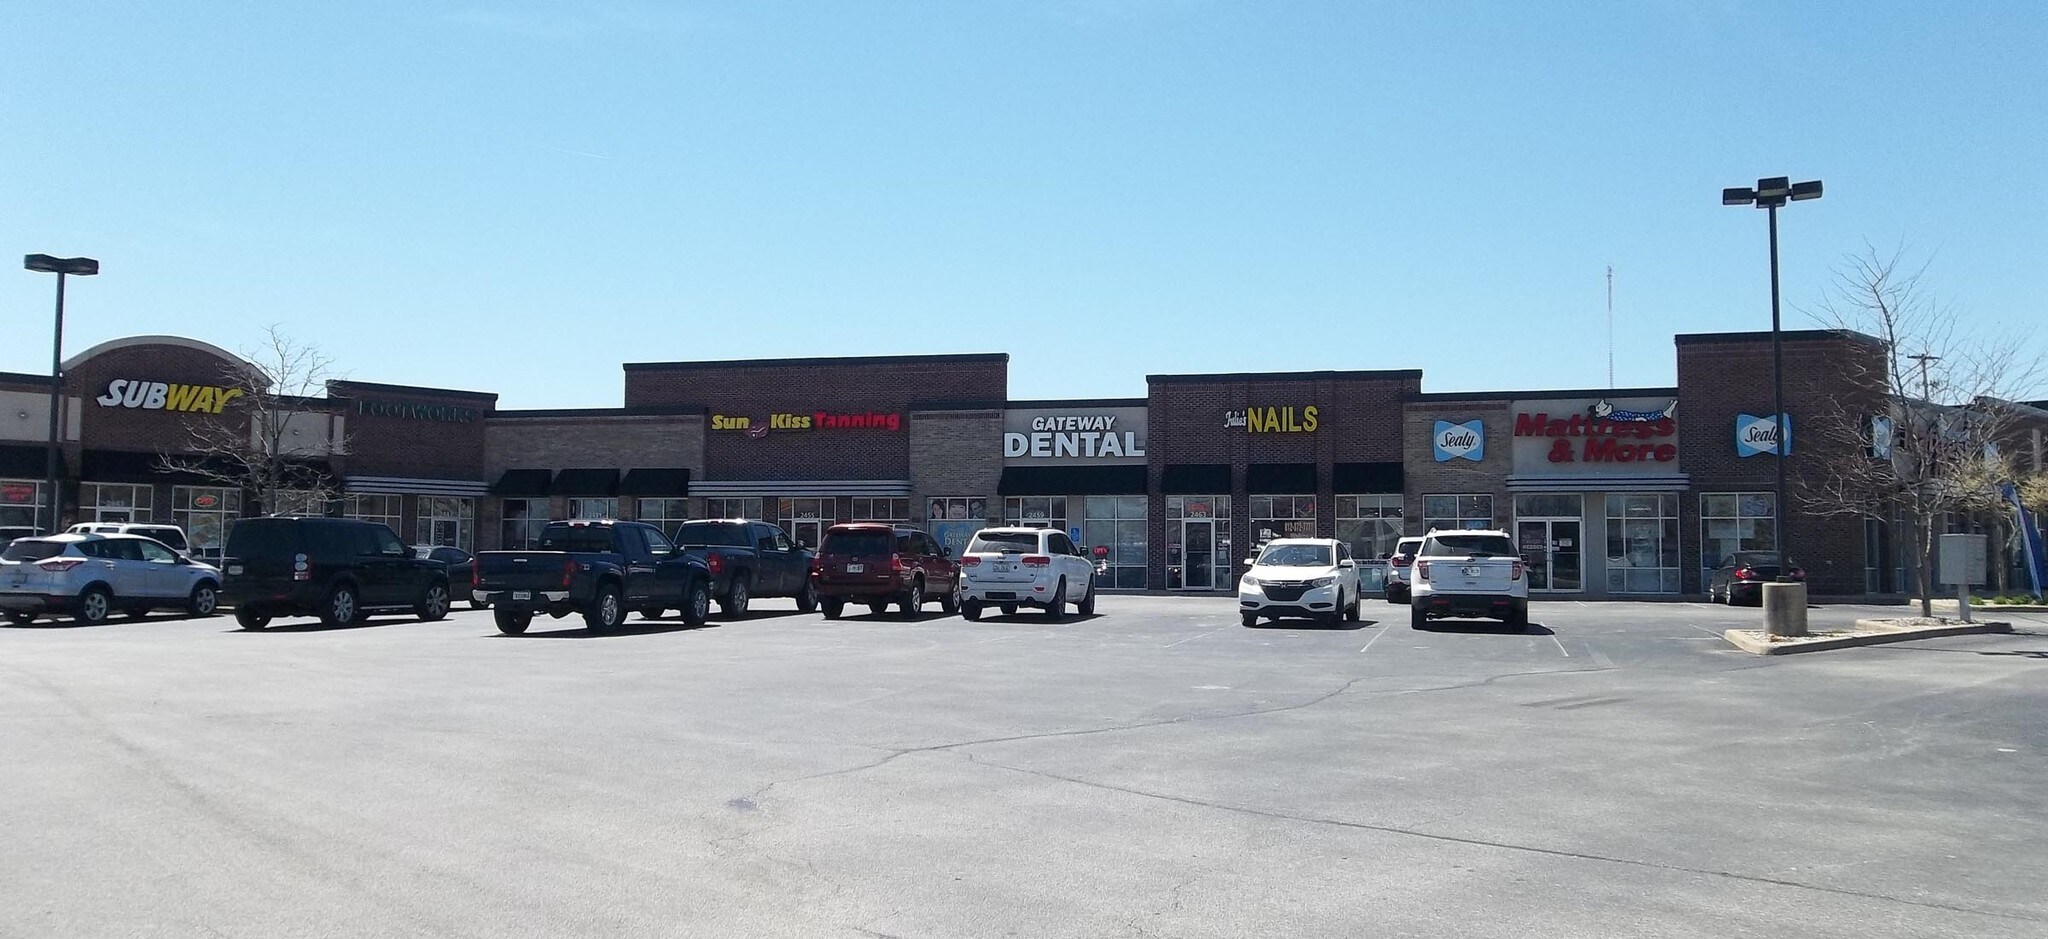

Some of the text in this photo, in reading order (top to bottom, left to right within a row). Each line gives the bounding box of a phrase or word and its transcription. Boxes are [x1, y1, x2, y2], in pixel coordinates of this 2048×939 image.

[97, 379, 244, 414] SUBWAY
[711, 412, 901, 431] Sun Kiss Tanning
[1032, 416, 1116, 431] GATEWAY
[1223, 405, 1318, 433] Julie's NAILS
[1514, 413, 1677, 439] Mattress
[1004, 431, 1146, 457] DENTAL
[1440, 431, 1475, 450] Sealy
[1547, 438, 1677, 463] & More
[944, 537, 971, 546] DENT
